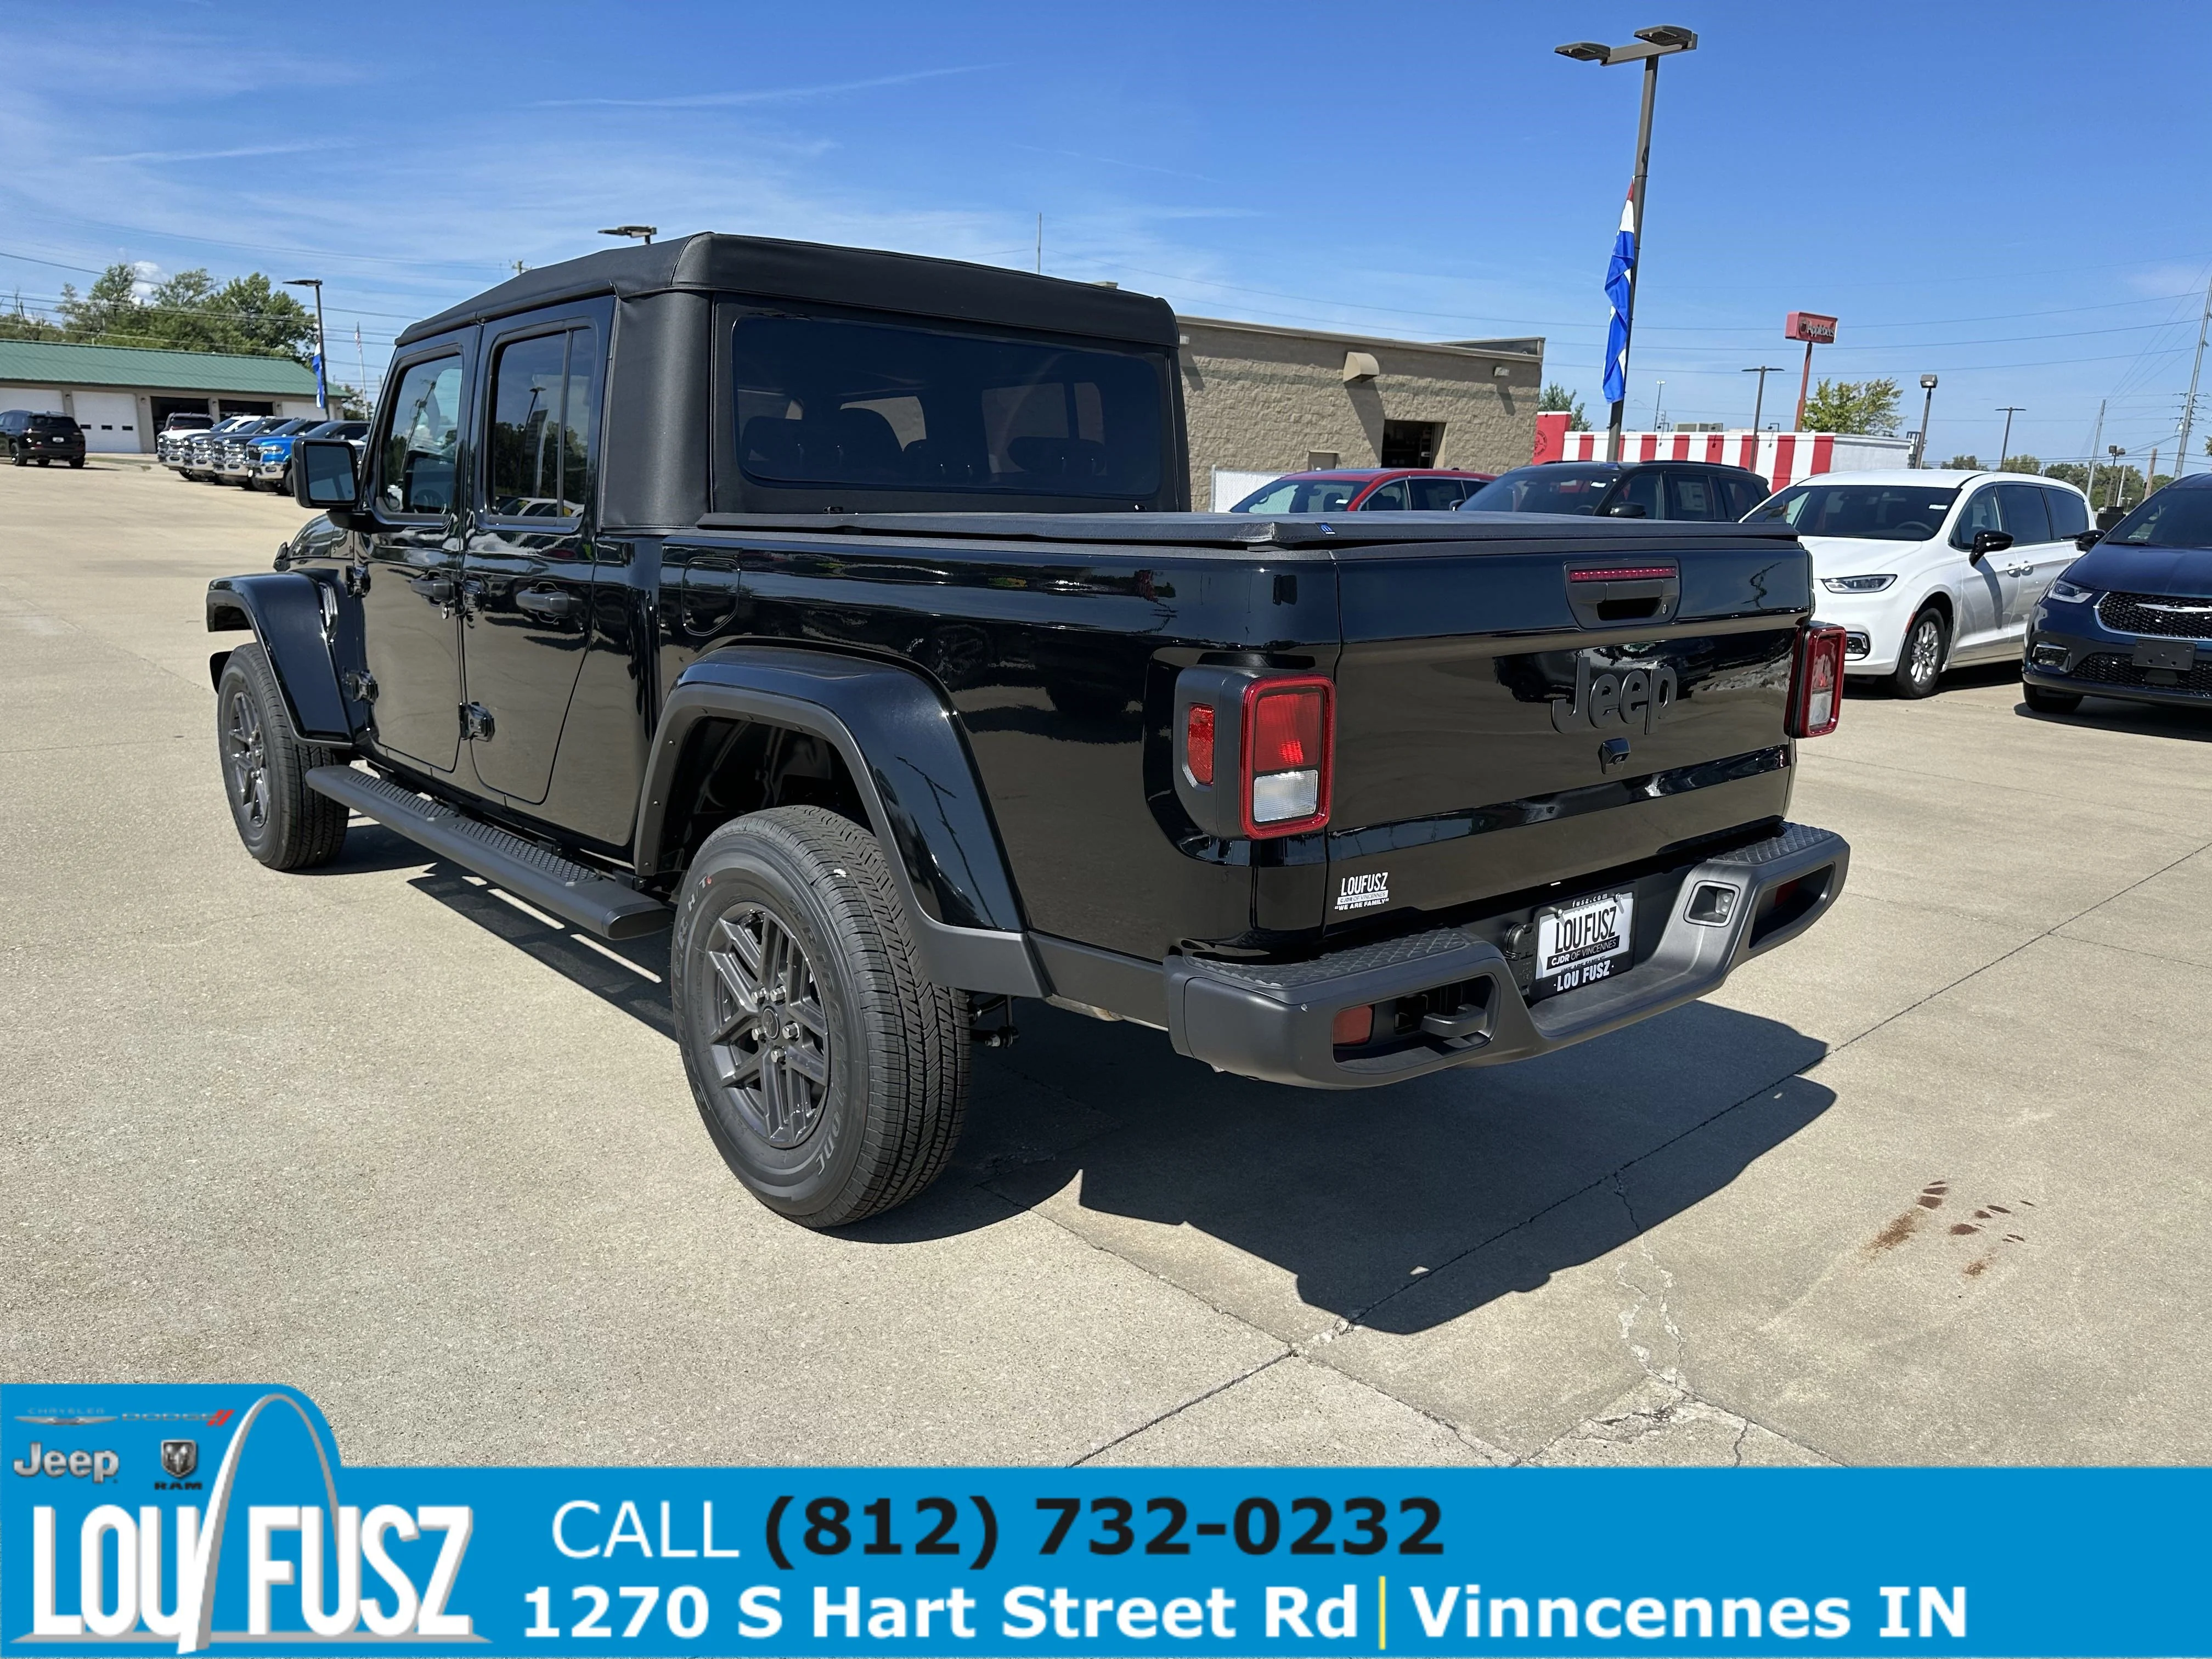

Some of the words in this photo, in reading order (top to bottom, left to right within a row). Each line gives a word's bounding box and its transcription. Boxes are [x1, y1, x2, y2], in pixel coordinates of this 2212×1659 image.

[1551, 656, 1678, 735] Jeep
[1572, 893, 1607, 907] fusz.com
[1555, 916, 1582, 953] LOU
[1583, 906, 1617, 946] FUSZ
[1551, 955, 1570, 966] CJDR
[1571, 951, 1581, 961] OF
[1582, 939, 1617, 957] VINCENNES
[1557, 970, 1579, 992] LOU
[1582, 960, 1611, 984] FUSZ
[786, 897, 848, 1177] BRIDGESTONE
